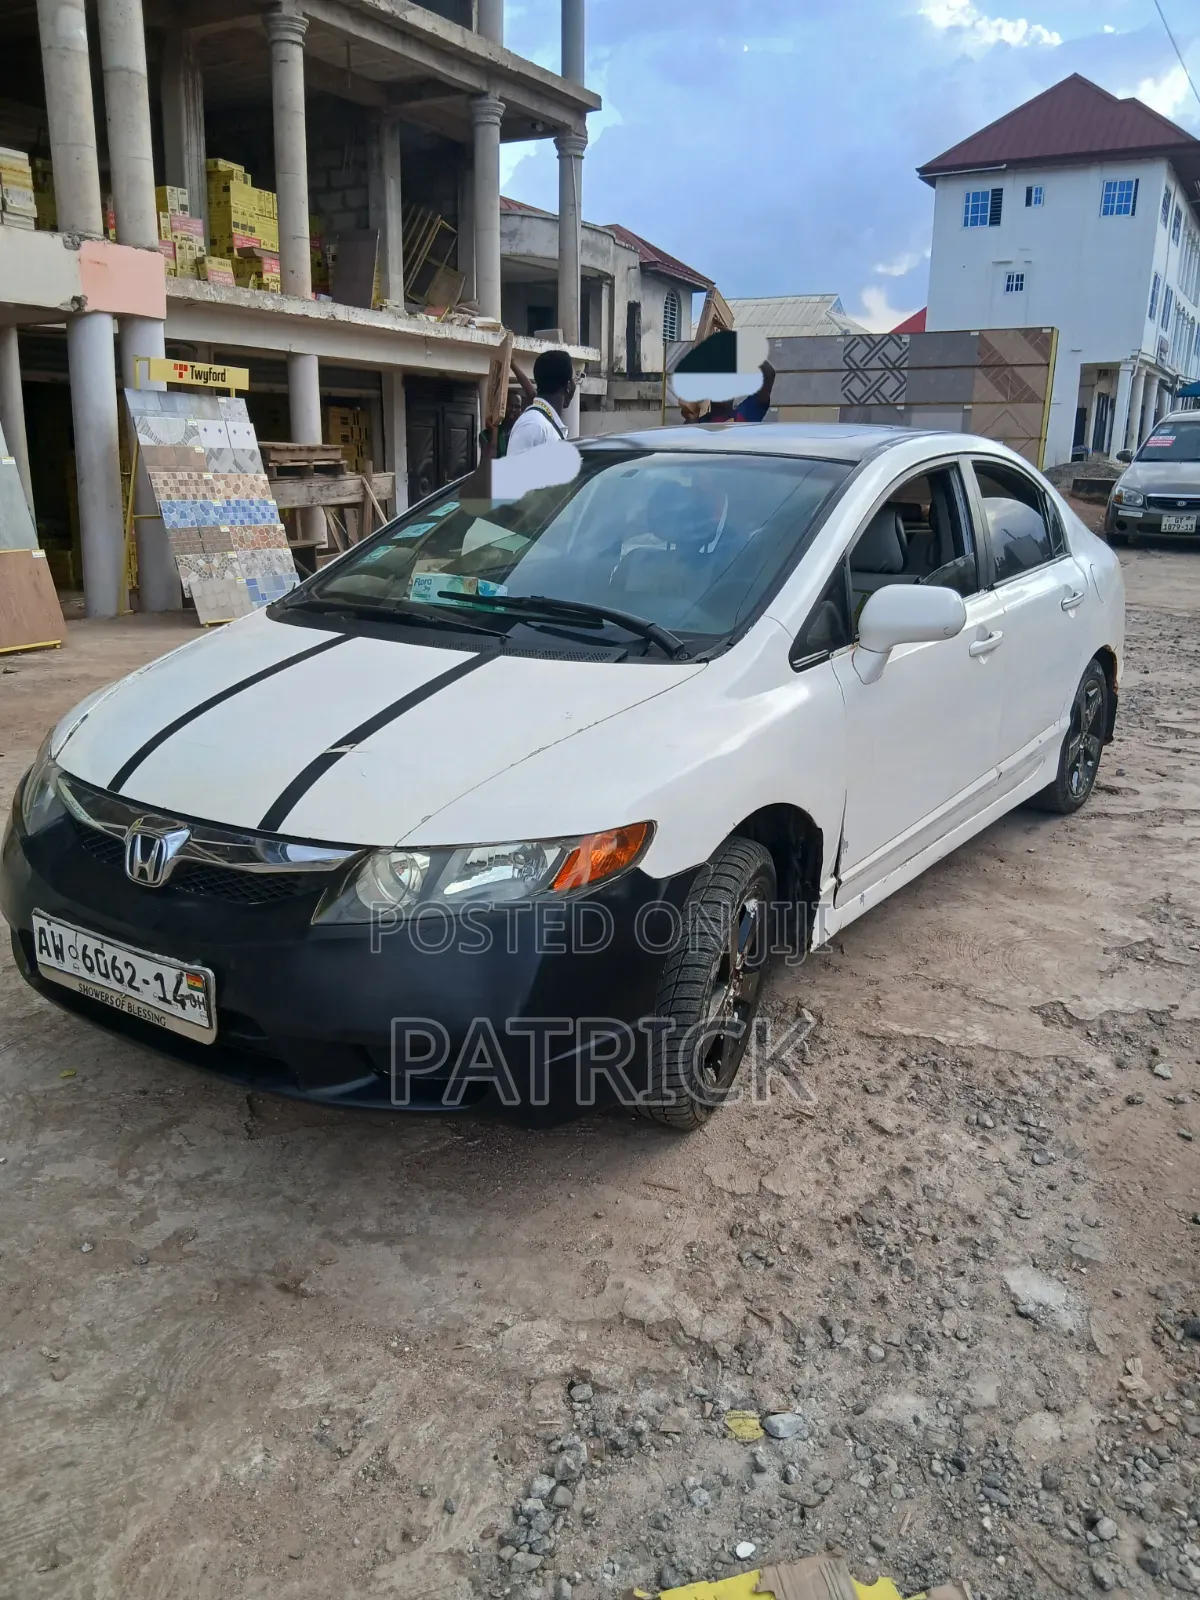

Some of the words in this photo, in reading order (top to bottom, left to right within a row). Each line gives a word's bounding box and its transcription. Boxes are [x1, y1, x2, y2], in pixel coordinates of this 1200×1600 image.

[190, 365, 226, 383] Twyford
[414, 578, 432, 587] Flora
[39, 926, 65, 962] AW
[78, 982, 114, 1006] SHOWERS
[115, 995, 126, 1010] OF
[127, 1001, 167, 1027] BLESSING
